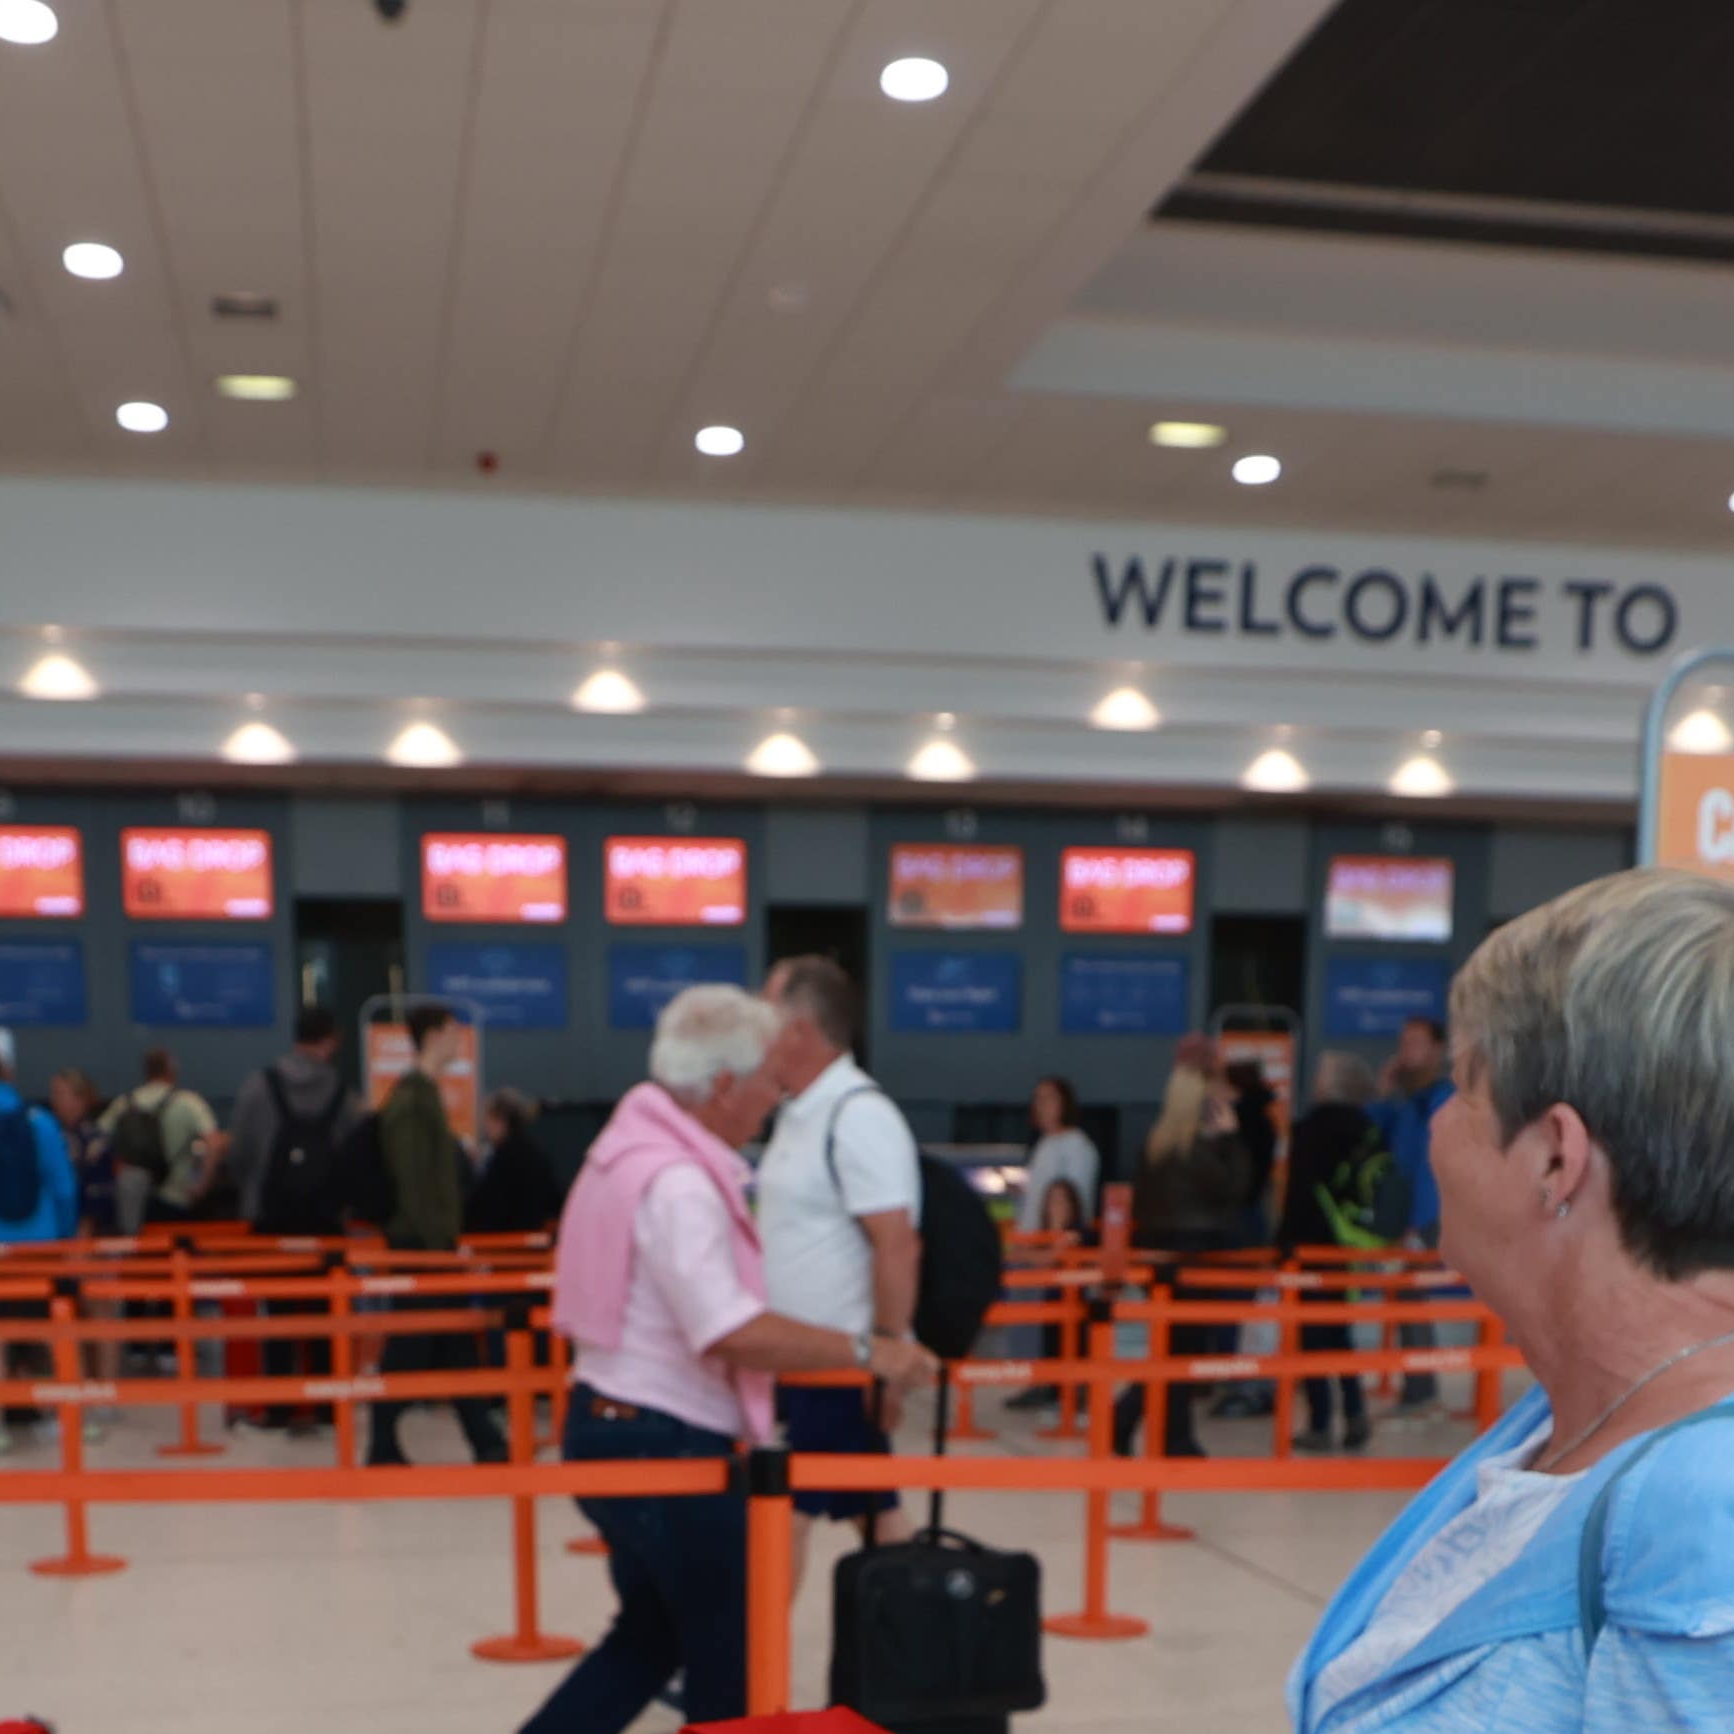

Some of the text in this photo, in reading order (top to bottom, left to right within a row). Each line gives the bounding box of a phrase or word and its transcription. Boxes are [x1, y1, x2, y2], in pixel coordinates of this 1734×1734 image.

[1091, 552, 1680, 656] WELCOME TO
[427, 842, 483, 876] BAG
[609, 845, 665, 879] BAG
[1065, 856, 1119, 889] BAG
